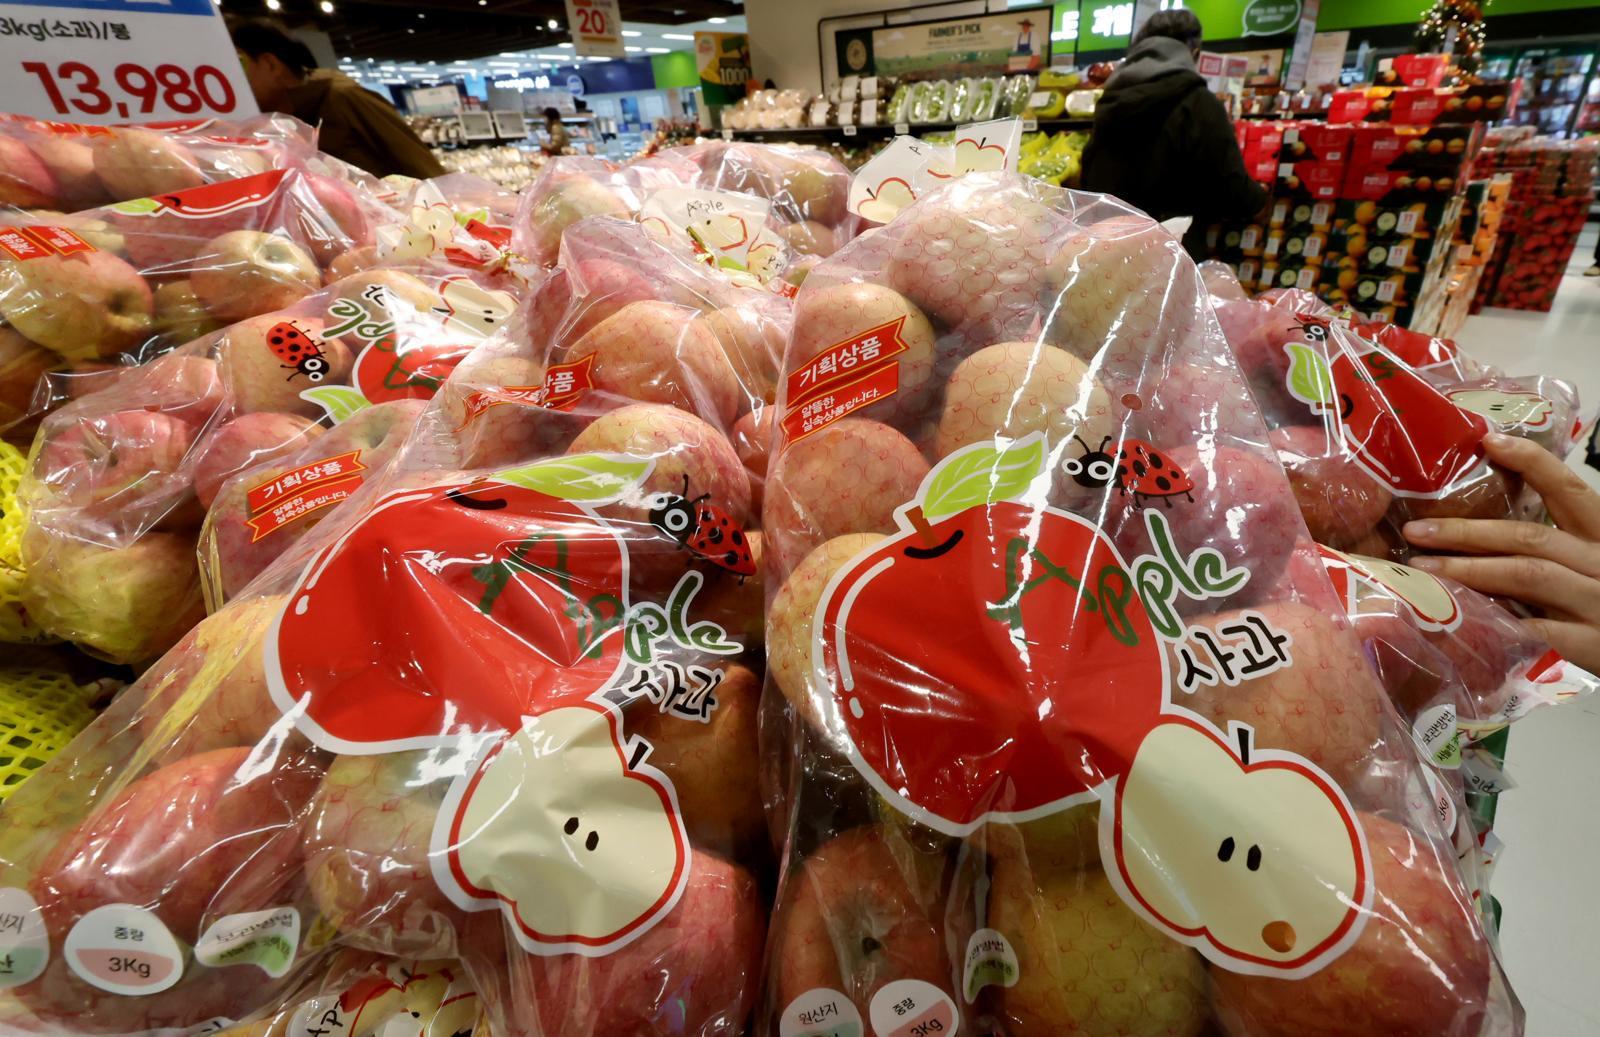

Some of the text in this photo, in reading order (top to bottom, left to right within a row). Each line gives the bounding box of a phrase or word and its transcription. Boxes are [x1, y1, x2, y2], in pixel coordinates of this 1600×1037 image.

[964, 23, 982, 36] PICK
[21, 61, 236, 118] 13,980
[799, 336, 882, 388] 기획상품
[262, 461, 342, 499] 기획상품
[986, 513, 1246, 646] Apple
[1179, 615, 1288, 688] 사과
[629, 662, 723, 719] 사과
[113, 926, 145, 941] 중량
[108, 956, 151, 979] 3Kg
[798, 1002, 839, 1026] 원산지
[893, 997, 917, 1016] 중량
